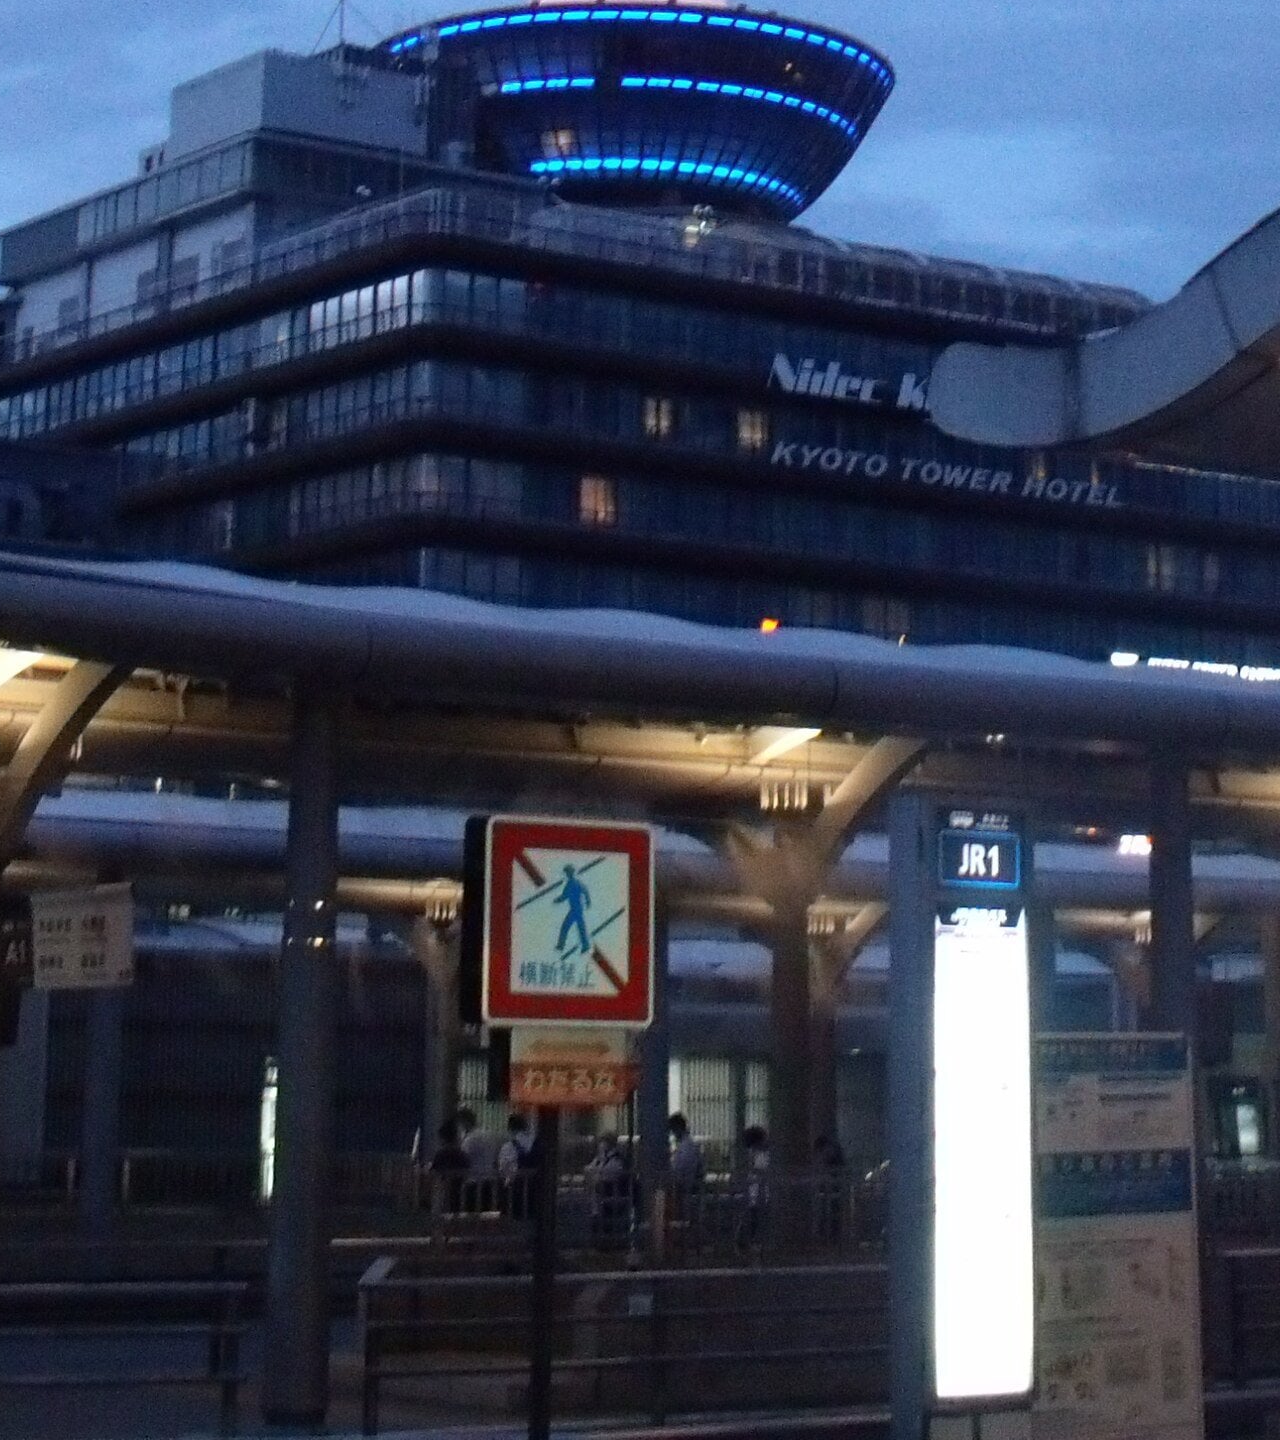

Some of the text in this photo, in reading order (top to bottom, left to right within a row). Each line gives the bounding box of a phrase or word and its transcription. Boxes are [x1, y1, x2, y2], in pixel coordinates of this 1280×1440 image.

[766, 352, 888, 403] Nidec
[771, 441, 1122, 508] KYOTO TOWER HOTEL
[958, 843, 1000, 877] JR1
